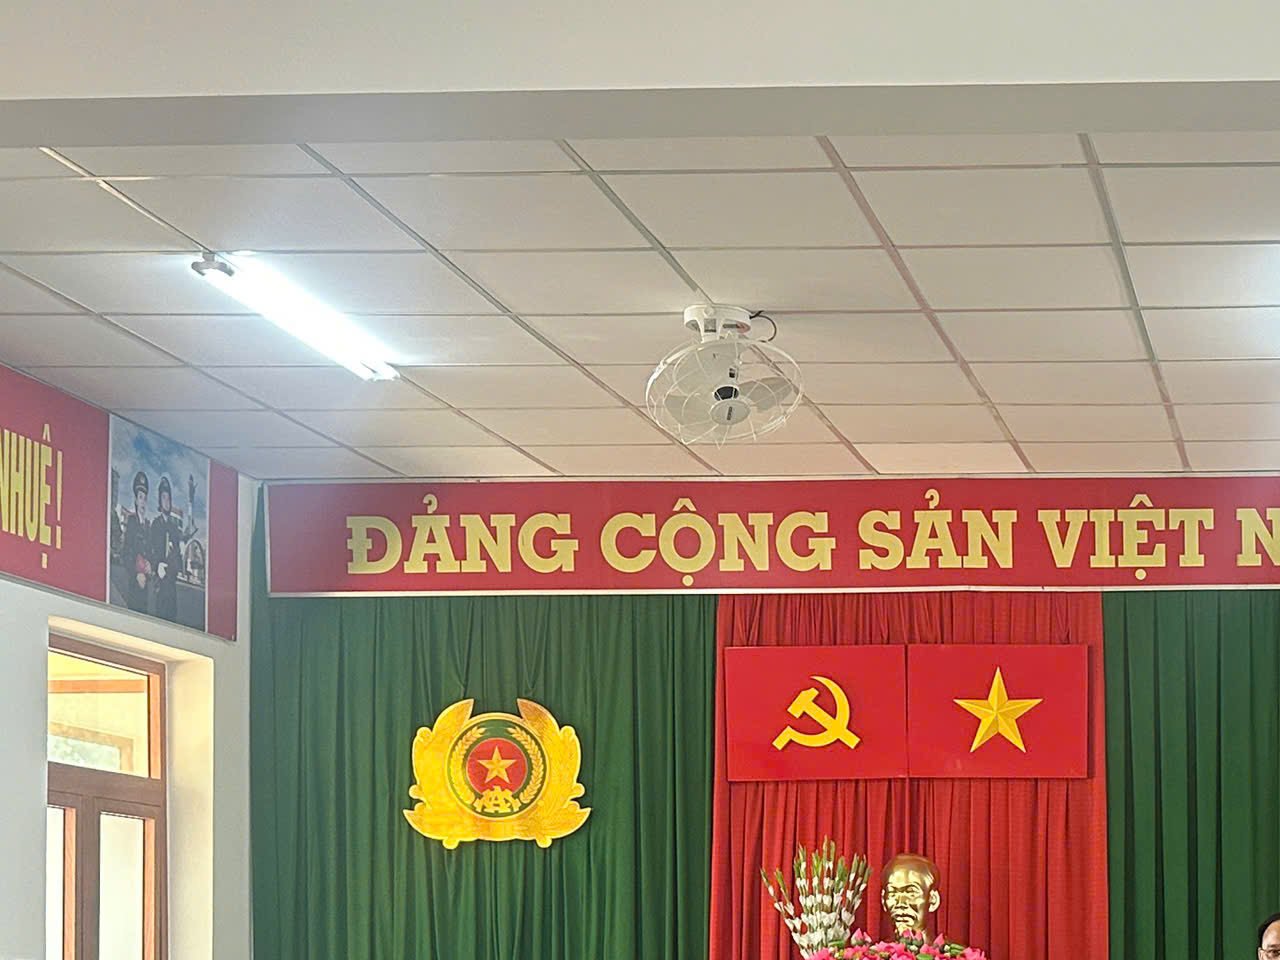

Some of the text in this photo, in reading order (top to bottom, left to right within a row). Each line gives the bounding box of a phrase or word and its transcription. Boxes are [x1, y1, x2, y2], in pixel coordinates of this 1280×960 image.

[346, 493, 579, 575] ĐẢNG
[600, 497, 836, 587] CỘNG
[857, 488, 1015, 571] SẢN
[1038, 494, 1214, 580] VIỆT
